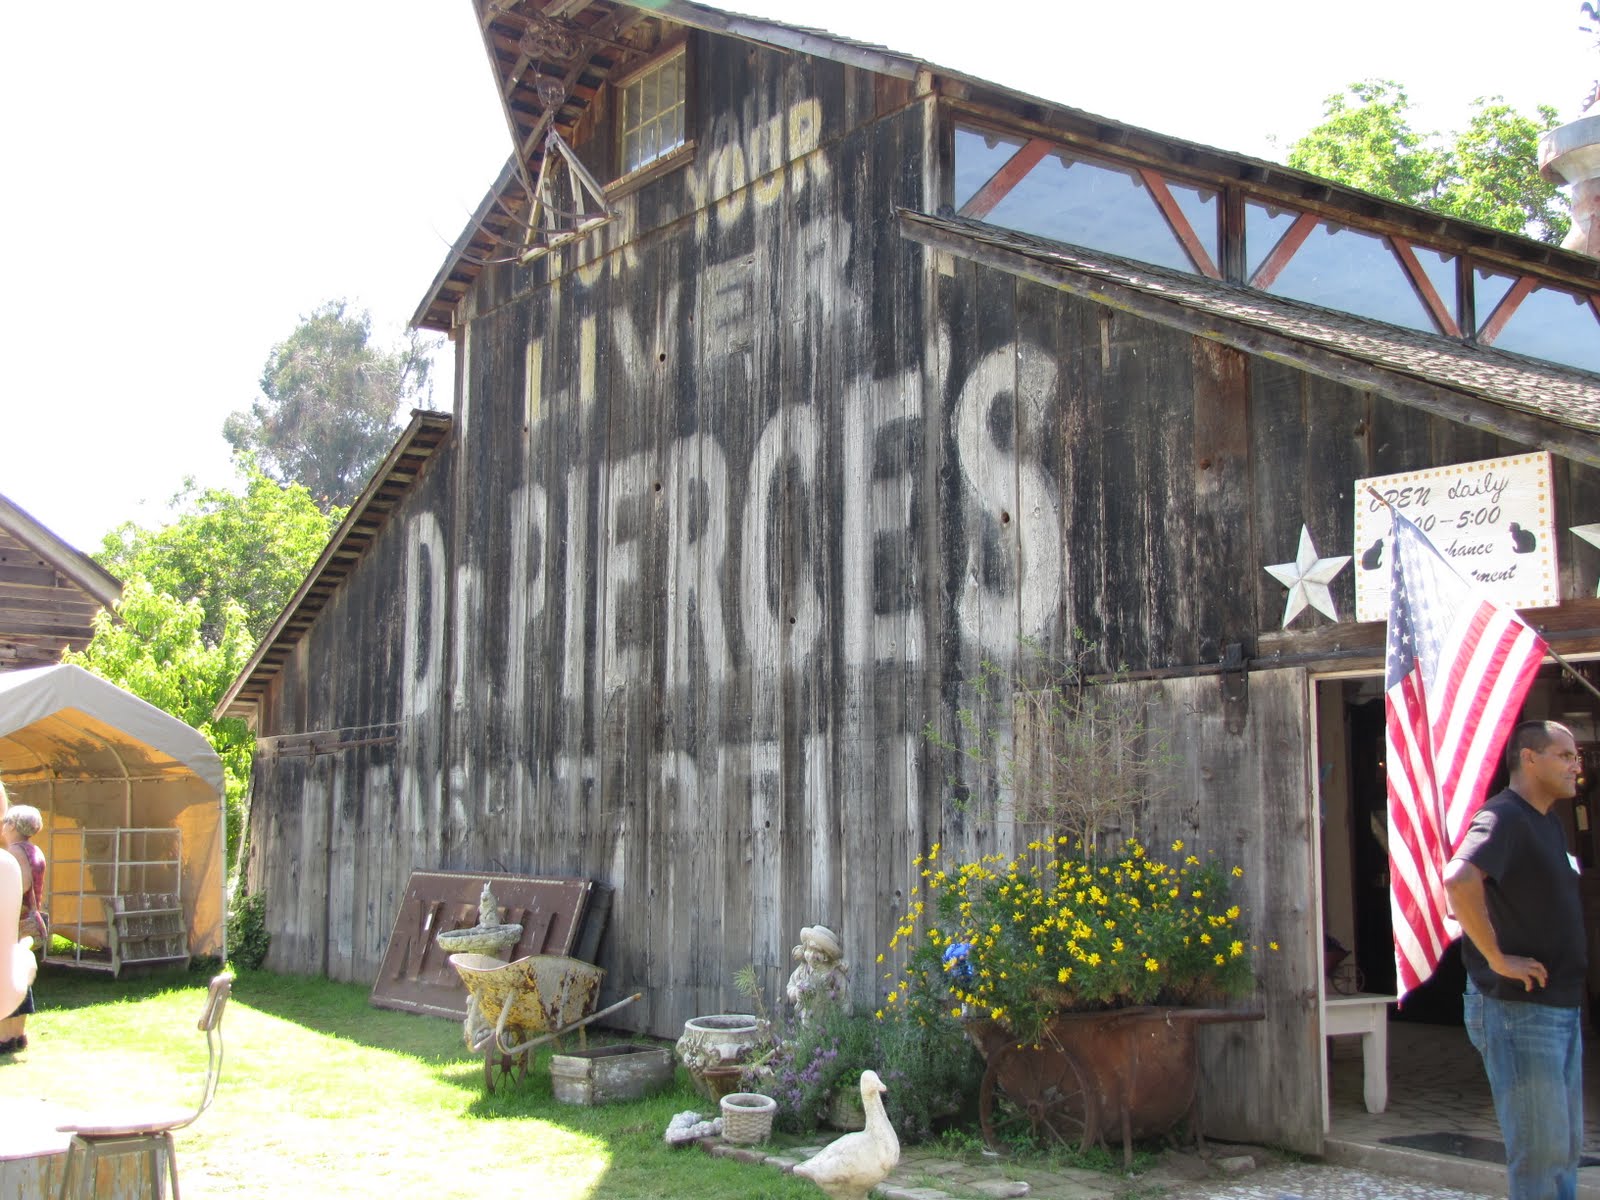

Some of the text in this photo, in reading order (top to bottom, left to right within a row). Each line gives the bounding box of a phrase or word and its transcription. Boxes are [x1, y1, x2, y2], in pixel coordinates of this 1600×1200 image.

[685, 97, 831, 246] YOUR
[1448, 472, 1509, 504] daily
[1445, 539, 1494, 558] hance
